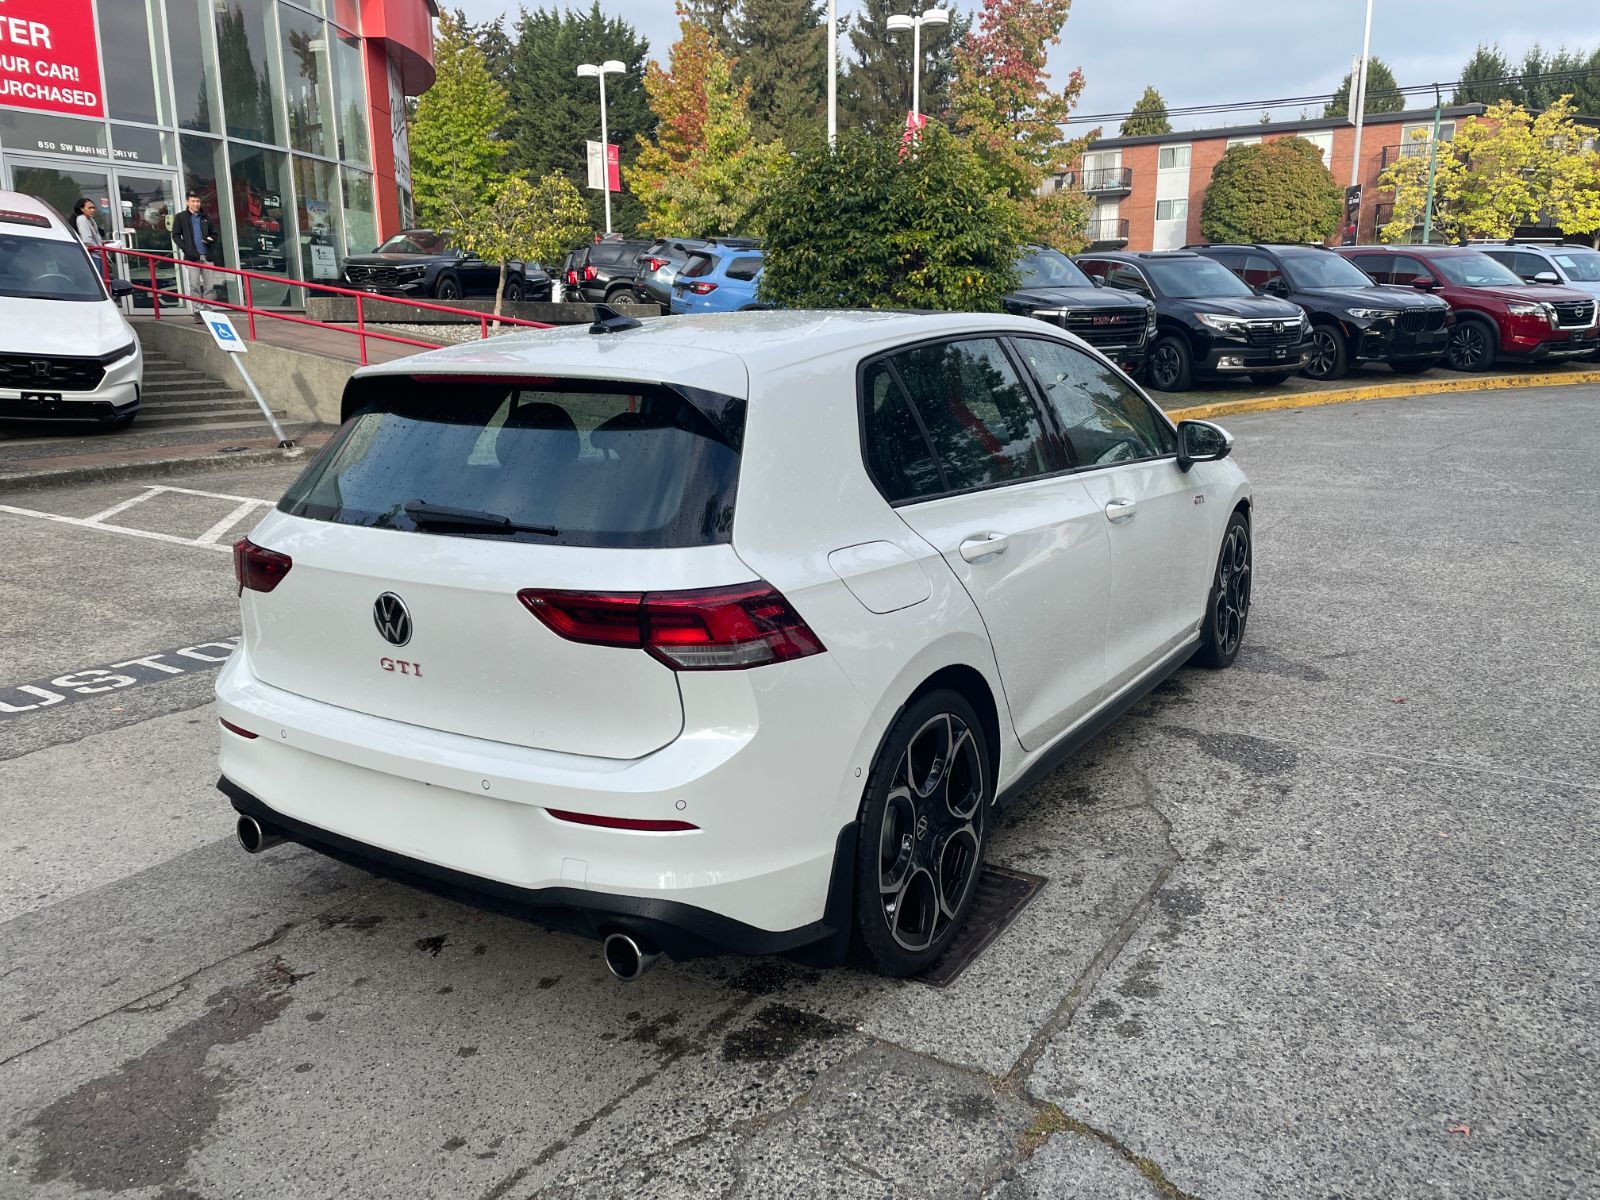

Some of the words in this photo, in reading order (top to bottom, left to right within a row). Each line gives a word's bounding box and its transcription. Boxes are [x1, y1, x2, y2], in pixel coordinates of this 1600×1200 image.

[0, 54, 31, 75] UR
[35, 60, 80, 82] CAR!
[37, 140, 56, 150] 850
[60, 143, 73, 152] SW
[75, 145, 108, 156] MARINE
[112, 149, 139, 159] DRIVE
[0, 636, 242, 713] USTO
[380, 657, 424, 678] GTI
